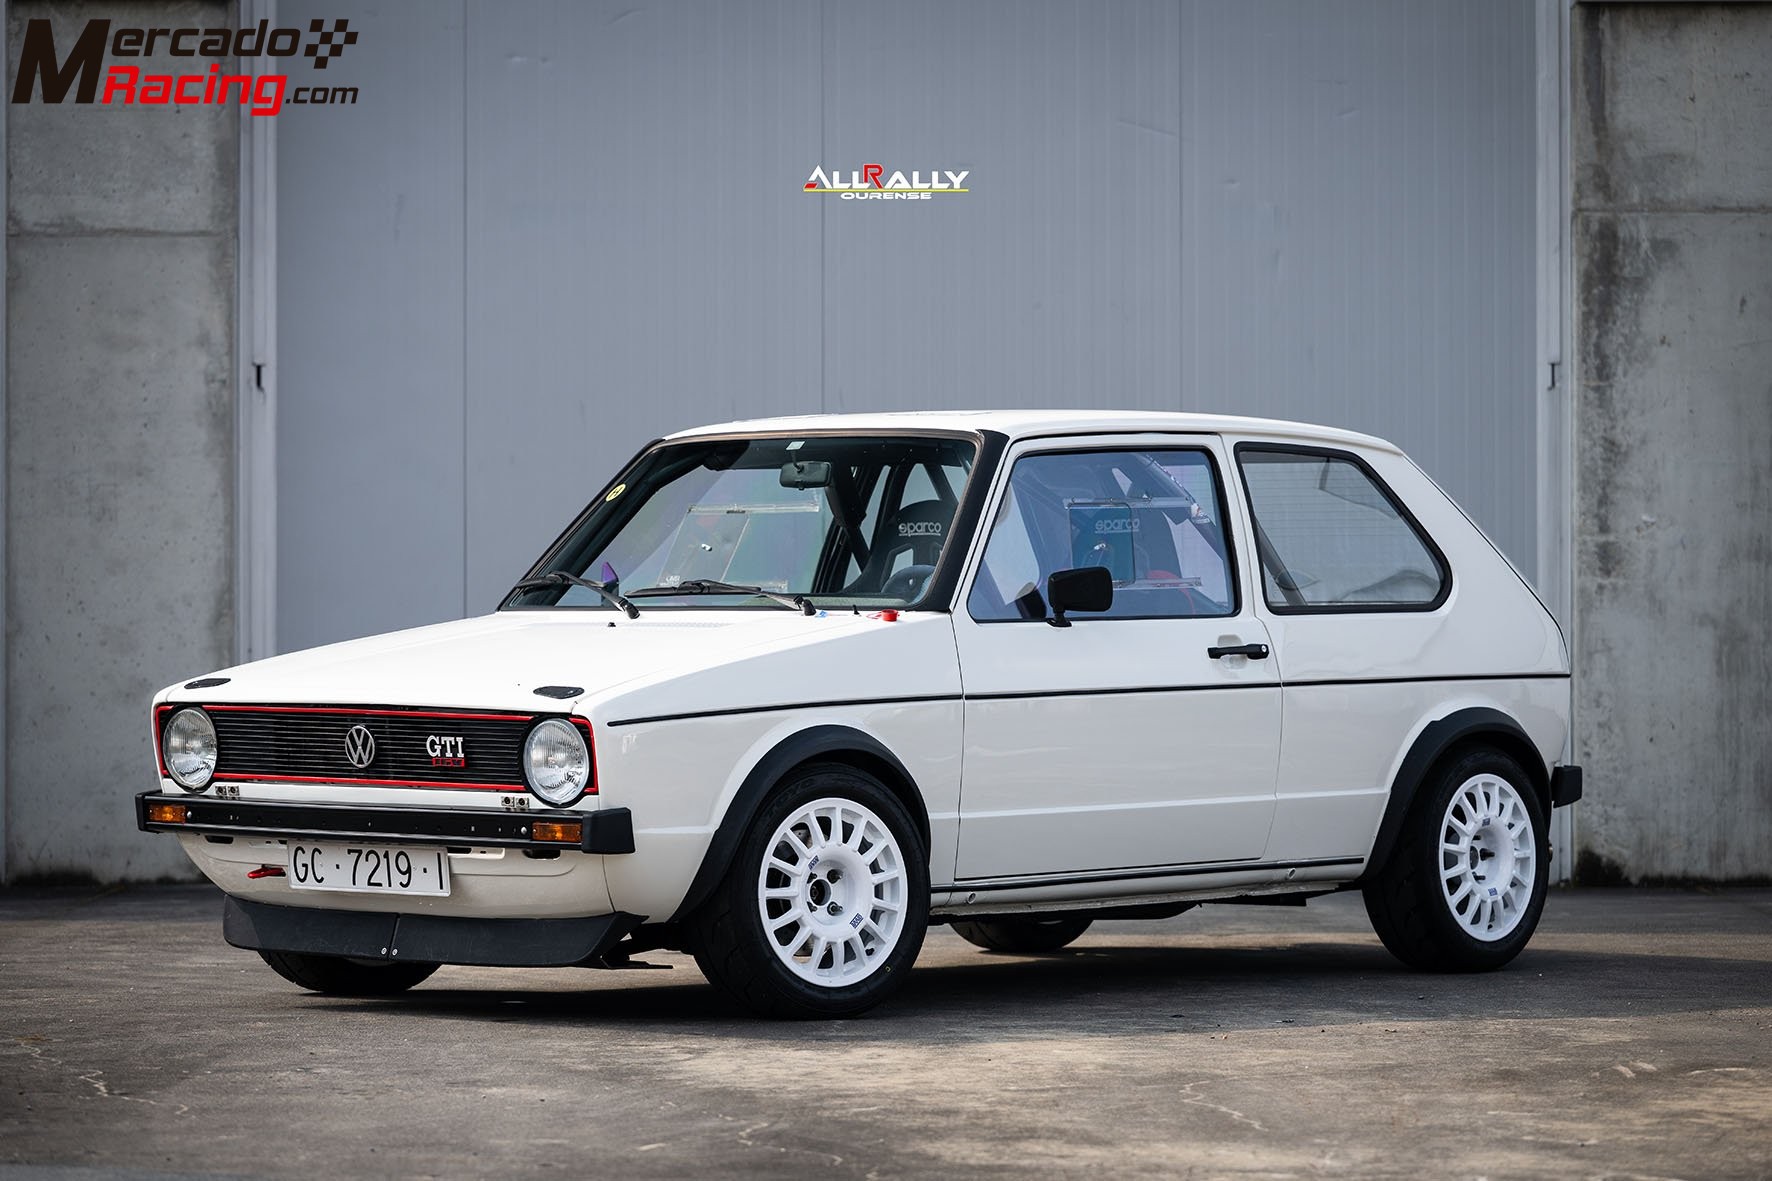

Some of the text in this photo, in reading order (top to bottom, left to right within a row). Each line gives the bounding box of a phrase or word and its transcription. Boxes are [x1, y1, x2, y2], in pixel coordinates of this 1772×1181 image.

[898, 522, 942, 537] sparco
[426, 735, 465, 758] GTI
[293, 846, 325, 884] GC
[347, 848, 413, 889] 7219
